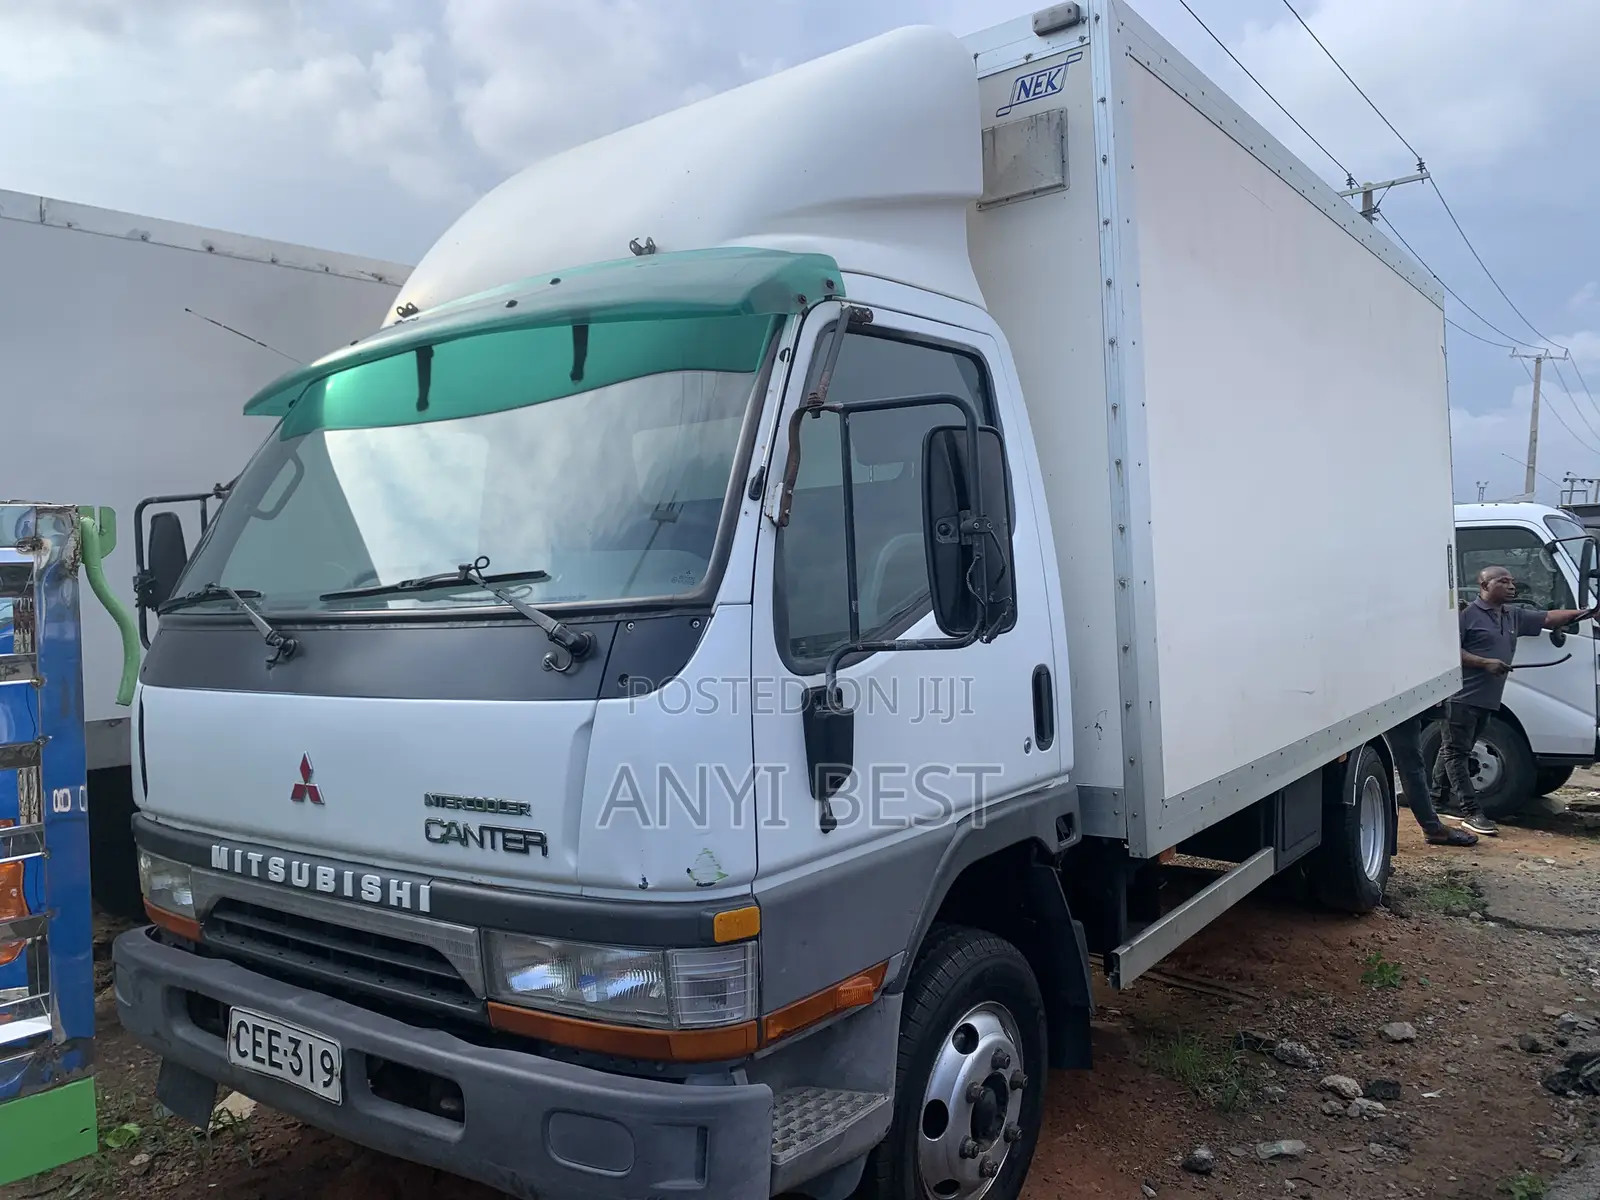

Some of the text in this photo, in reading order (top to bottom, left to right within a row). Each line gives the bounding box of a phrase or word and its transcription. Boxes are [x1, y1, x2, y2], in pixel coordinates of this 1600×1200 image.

[1016, 67, 1064, 101] NEK
[424, 792, 532, 816] INTERCOOLER
[424, 817, 549, 858] CANTER
[211, 844, 432, 913] MITSUBISHI
